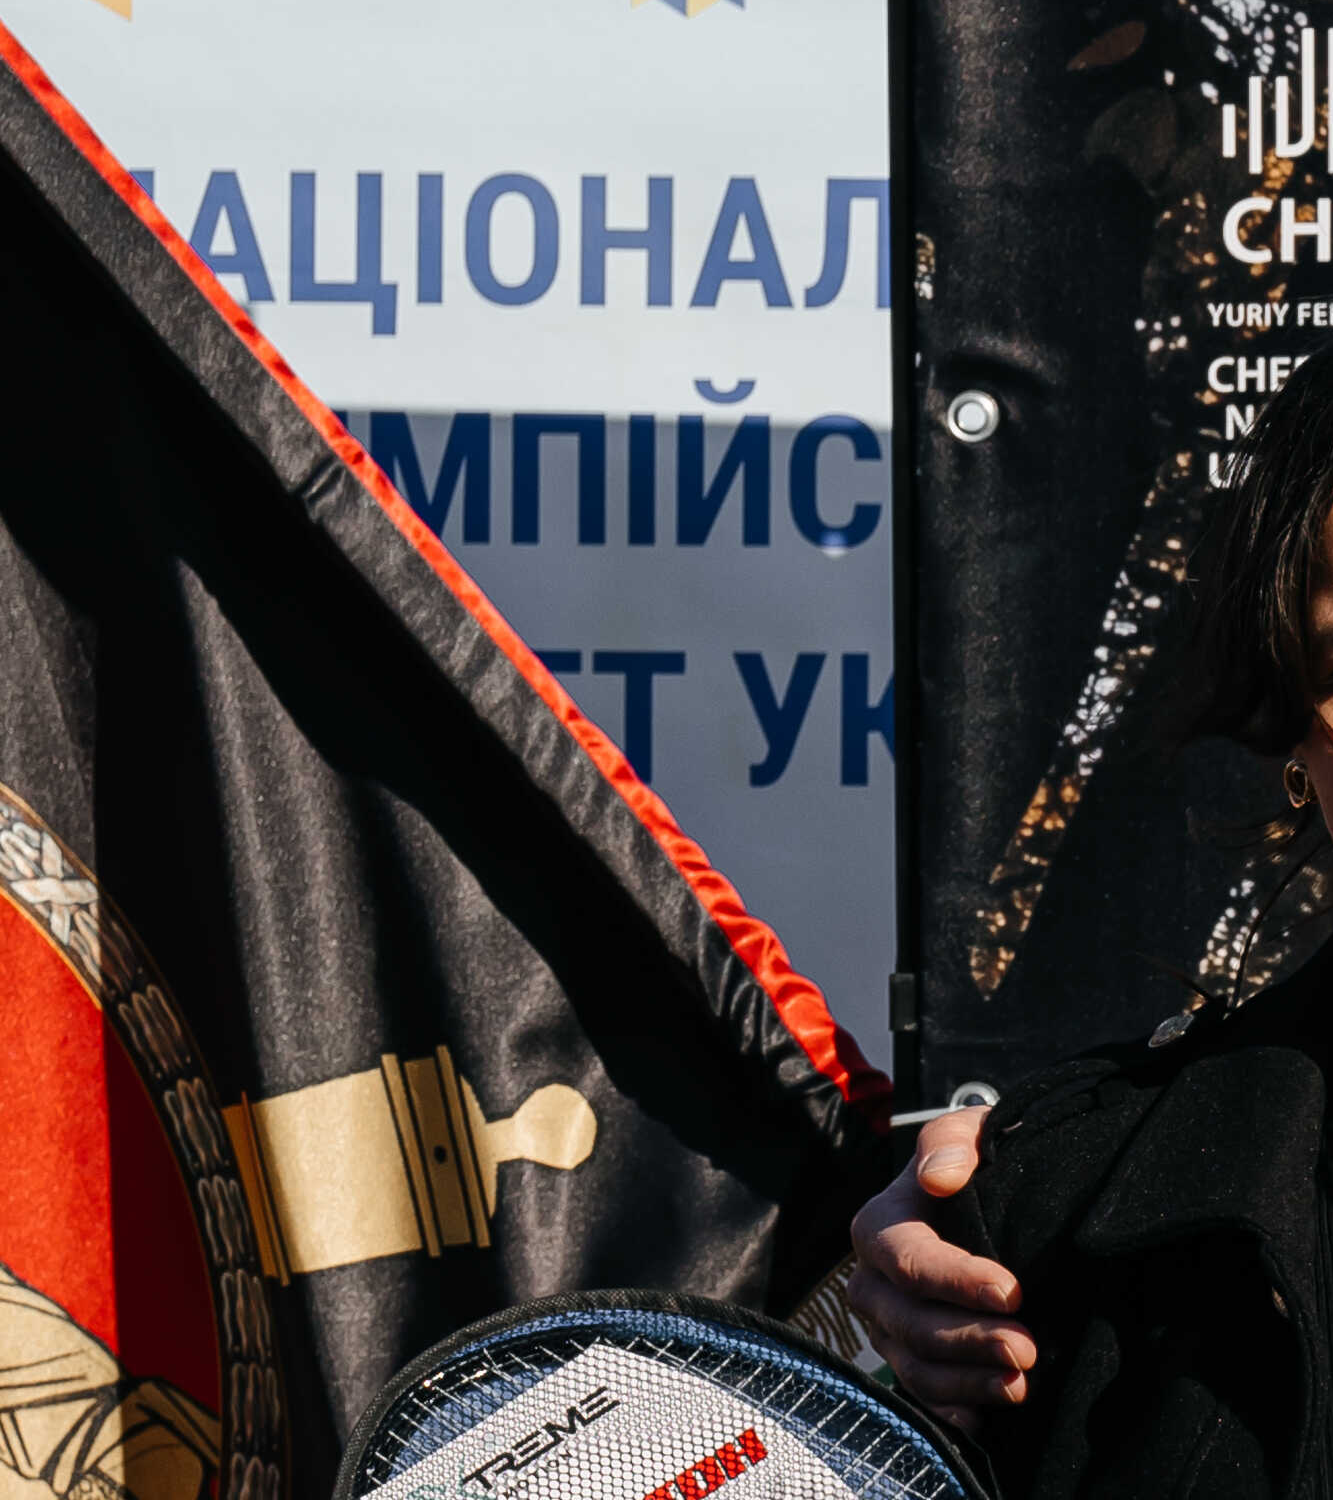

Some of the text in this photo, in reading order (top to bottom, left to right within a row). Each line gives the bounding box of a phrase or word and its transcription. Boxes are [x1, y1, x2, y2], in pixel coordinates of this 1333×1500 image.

[128, 169, 891, 335] АЦІОНАЛ
[1207, 302, 1290, 327] YURIY
[330, 380, 882, 547] МПІЙС
